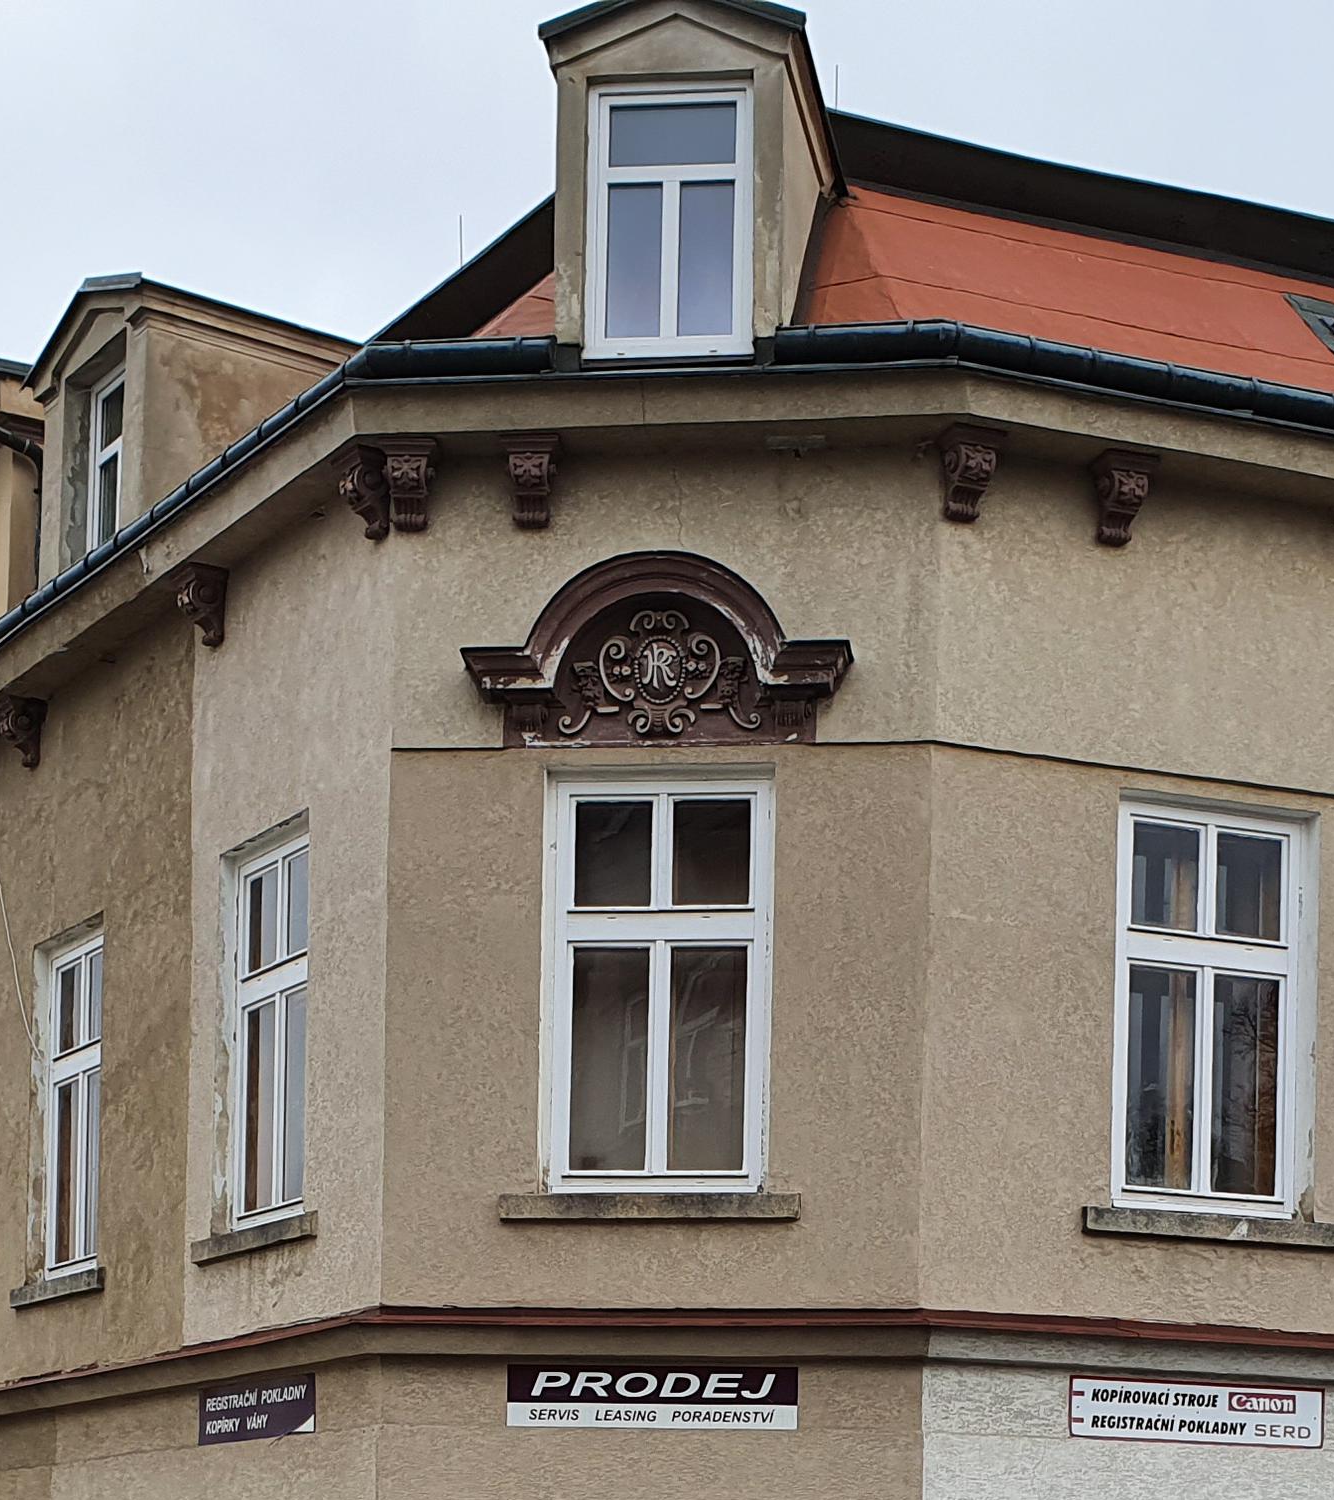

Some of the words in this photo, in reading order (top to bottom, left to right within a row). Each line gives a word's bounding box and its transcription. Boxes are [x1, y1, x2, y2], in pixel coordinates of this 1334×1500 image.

[206, 1388, 258, 1412] REGISTRAČNÍ
[261, 1384, 307, 1405] POKLADNY
[530, 1371, 776, 1399] PRODEJ
[1091, 1385, 1171, 1407] KOPÍROVACÍ
[1172, 1392, 1219, 1409] STROJE
[1230, 1393, 1295, 1414] Canon
[205, 1416, 241, 1435] KOPÍRKY
[246, 1412, 269, 1430] VÁHY
[528, 1408, 580, 1422] SERVIS
[594, 1409, 658, 1423] LEASING
[671, 1409, 775, 1424] PORADENSTVÍ
[1090, 1413, 1176, 1433] REGISTRAČNÍ
[1178, 1418, 1247, 1436] POKLADNY
[1253, 1423, 1312, 1440] SERD
